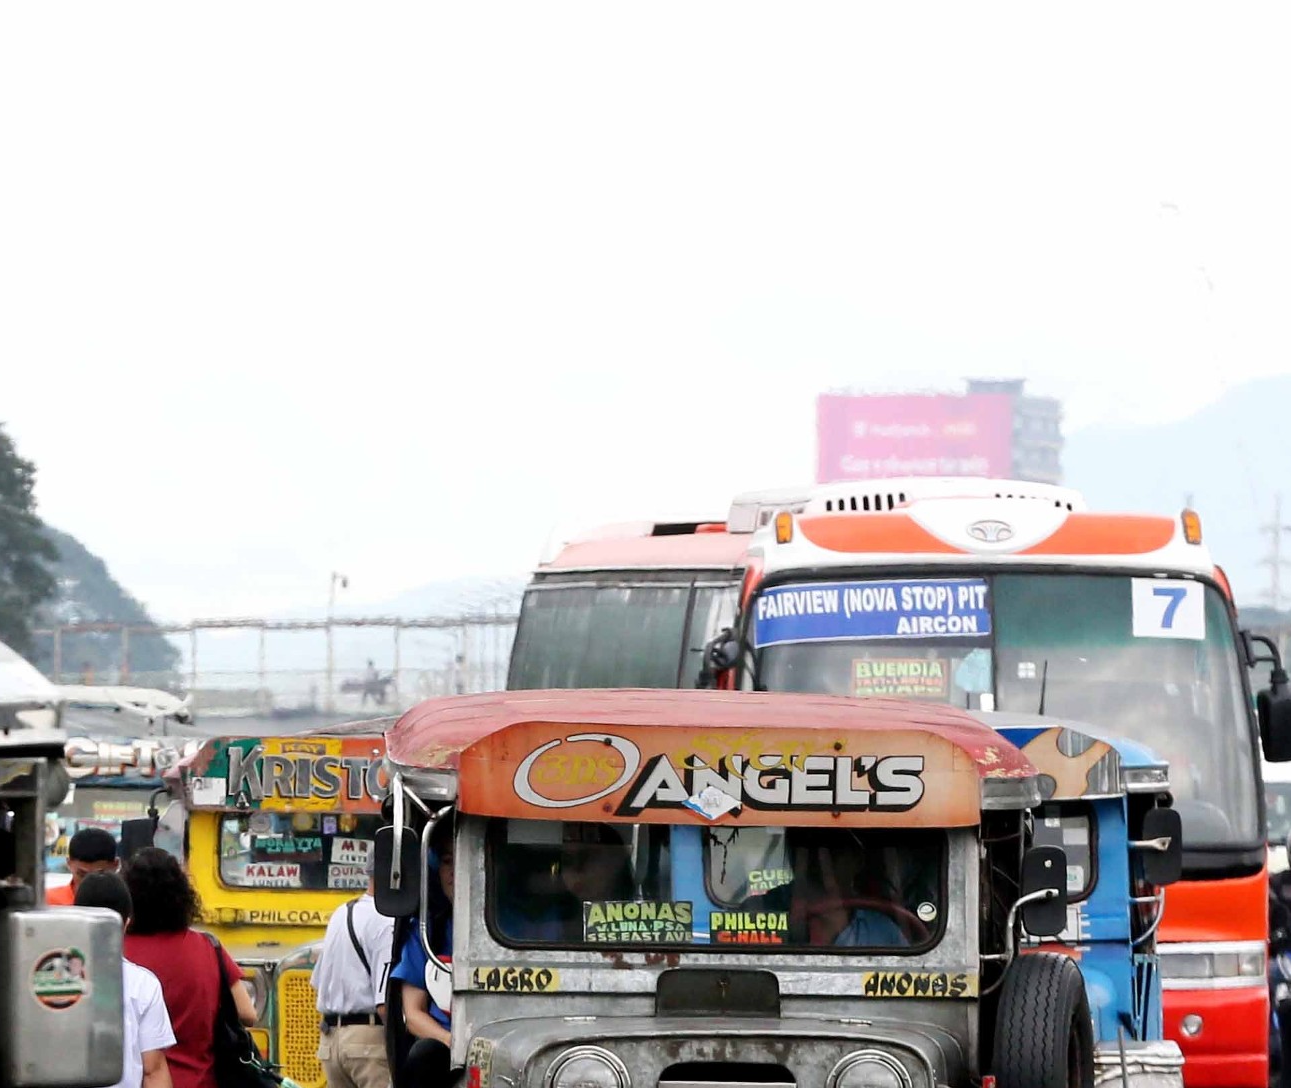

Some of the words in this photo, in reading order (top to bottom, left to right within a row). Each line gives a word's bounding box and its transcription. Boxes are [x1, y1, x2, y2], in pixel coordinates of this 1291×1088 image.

[758, 589, 839, 621] FAIRVIEW
[843, 587, 898, 618] (NOVA
[900, 585, 954, 615] STOP)
[958, 584, 988, 610] PIT
[1152, 587, 1188, 629] 7
[896, 615, 978, 634] AIRCON
[856, 661, 943, 678] BUENDIA
[615, 753, 926, 818] ANGEL'S
[245, 865, 299, 878] KALAW
[587, 902, 692, 926] ANONAS
[711, 912, 789, 931] PHILCOA
[586, 932, 617, 942] SSS
[621, 931, 661, 942] EAST
[472, 967, 554, 992] LAGRO
[864, 971, 968, 997] ANONAS
